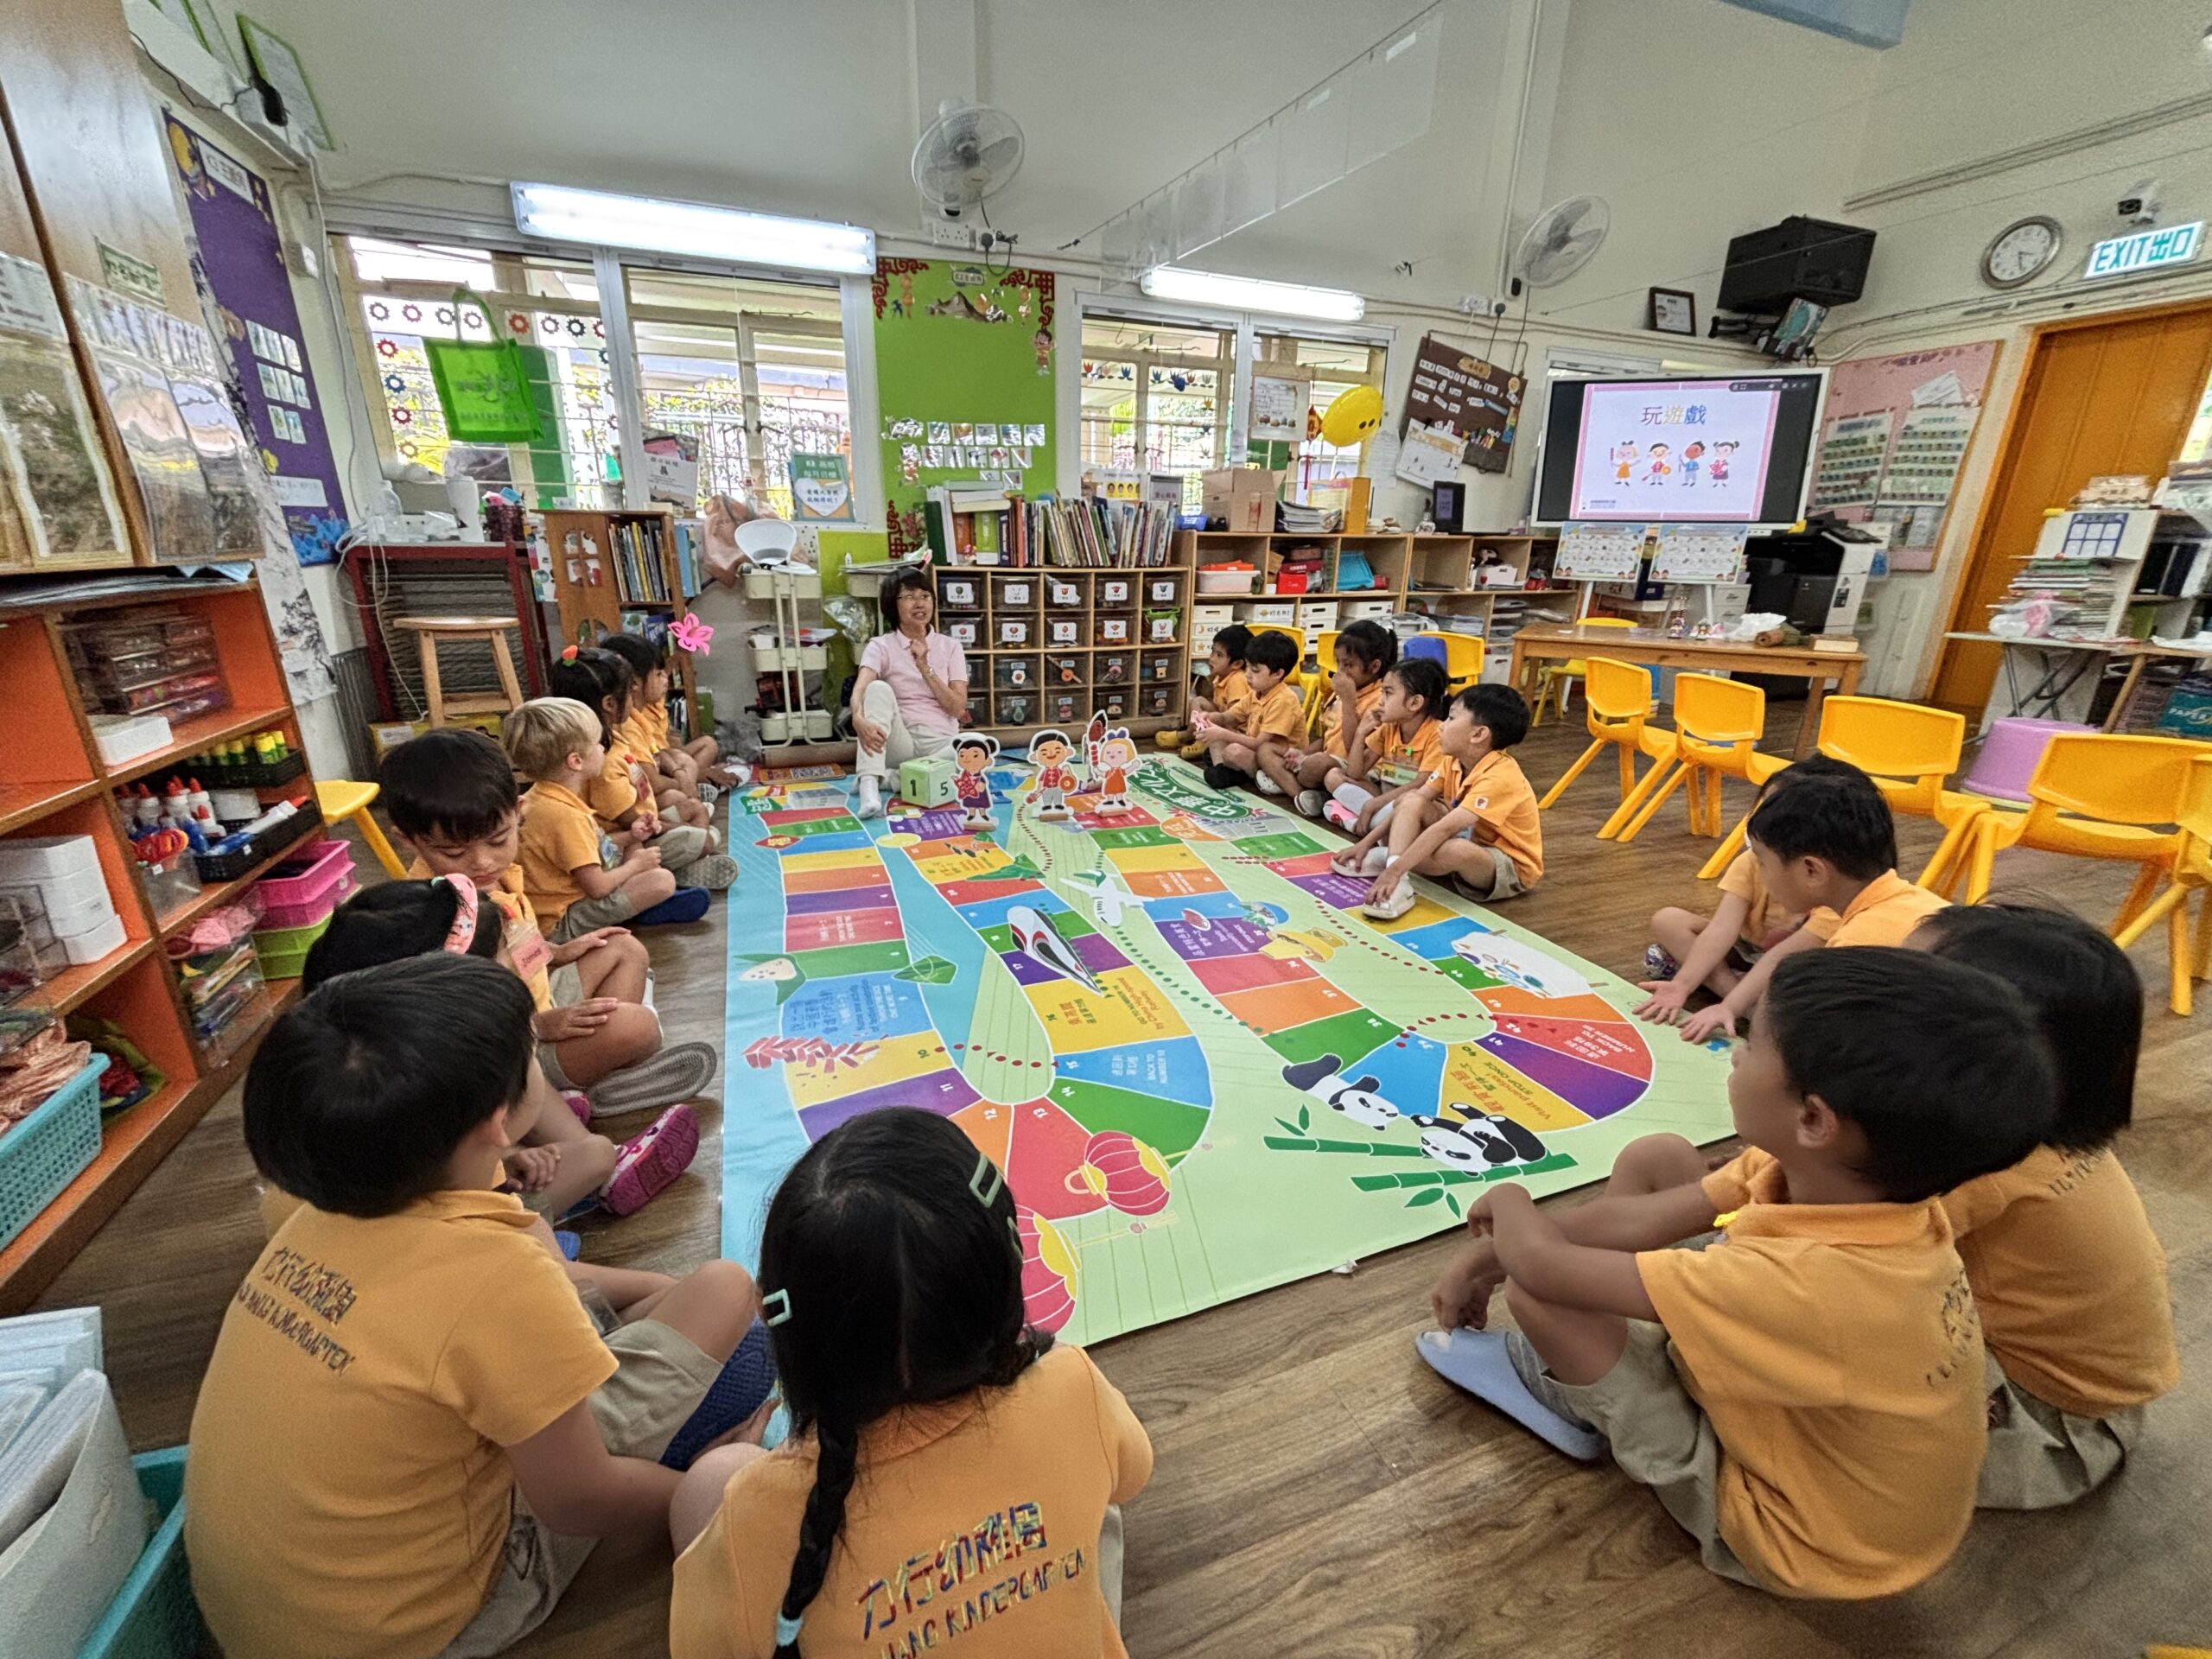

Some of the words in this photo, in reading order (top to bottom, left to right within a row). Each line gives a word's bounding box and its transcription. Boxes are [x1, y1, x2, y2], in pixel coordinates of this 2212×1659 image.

[2094, 235, 2152, 272] EXIT
[2147, 227, 2195, 262] 出口
[1641, 404, 1707, 426] 玩遊戲
[910, 779, 917, 797] 1
[940, 781, 949, 797] 5
[1322, 989, 1338, 998] 37
[1487, 998, 1502, 1008] 43
[1367, 1018, 1382, 1028] 38
[1505, 1022, 1521, 1033] 42
[1488, 1036, 1503, 1046] 41
[1596, 1029, 1636, 1053] NUMBER
[1598, 1035, 1624, 1053] BACK
[1461, 1046, 1478, 1058] 40
[1065, 1060, 1079, 1069] 15
[1147, 1064, 1156, 1081] BACK
[1158, 1057, 1167, 1084] NUMBER
[1483, 1061, 1509, 1078] ONCE
[940, 1082, 953, 1092] 11
[1061, 1086, 1076, 1097] 14
[1486, 1072, 1529, 1103] pandas!
[1508, 1077, 1533, 1096] STOP
[983, 1107, 998, 1121] 12
[1033, 1107, 1049, 1119] 13
[1528, 1100, 1551, 1120] Visit
[855, 1502, 1047, 1640] 力行幼稚園
[945, 1548, 1085, 1637] KINDERGARTEN
